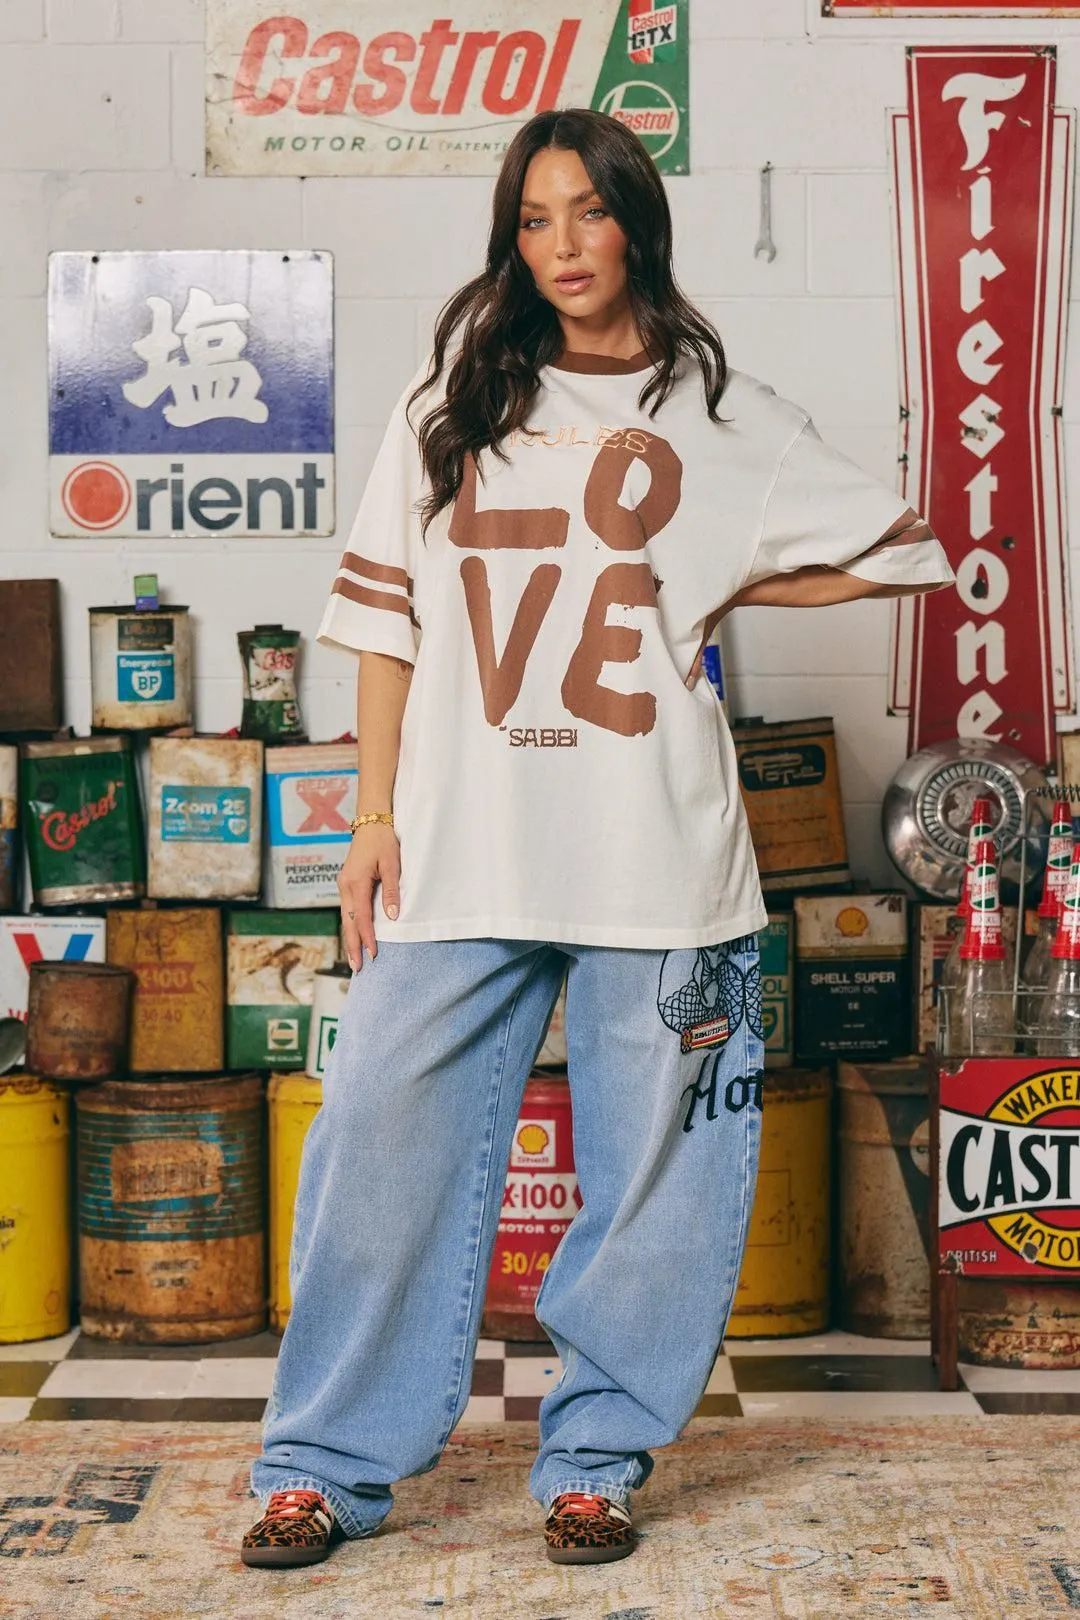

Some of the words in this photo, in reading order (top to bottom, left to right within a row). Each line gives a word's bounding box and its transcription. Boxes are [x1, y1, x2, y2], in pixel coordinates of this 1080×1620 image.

[631, 8, 674, 31] Castrol
[632, 23, 672, 50] GTX
[233, 16, 582, 117] Castrol
[264, 135, 366, 152] MOTOR
[386, 135, 430, 152] OIL
[940, 73, 1027, 742] Firestone
[138, 676, 160, 691] BP
[509, 728, 578, 748] SABBI
[165, 797, 218, 815] Zoom
[222, 798, 247, 816] 25
[811, 973, 851, 985] SHELL
[854, 971, 896, 984] SUPER
